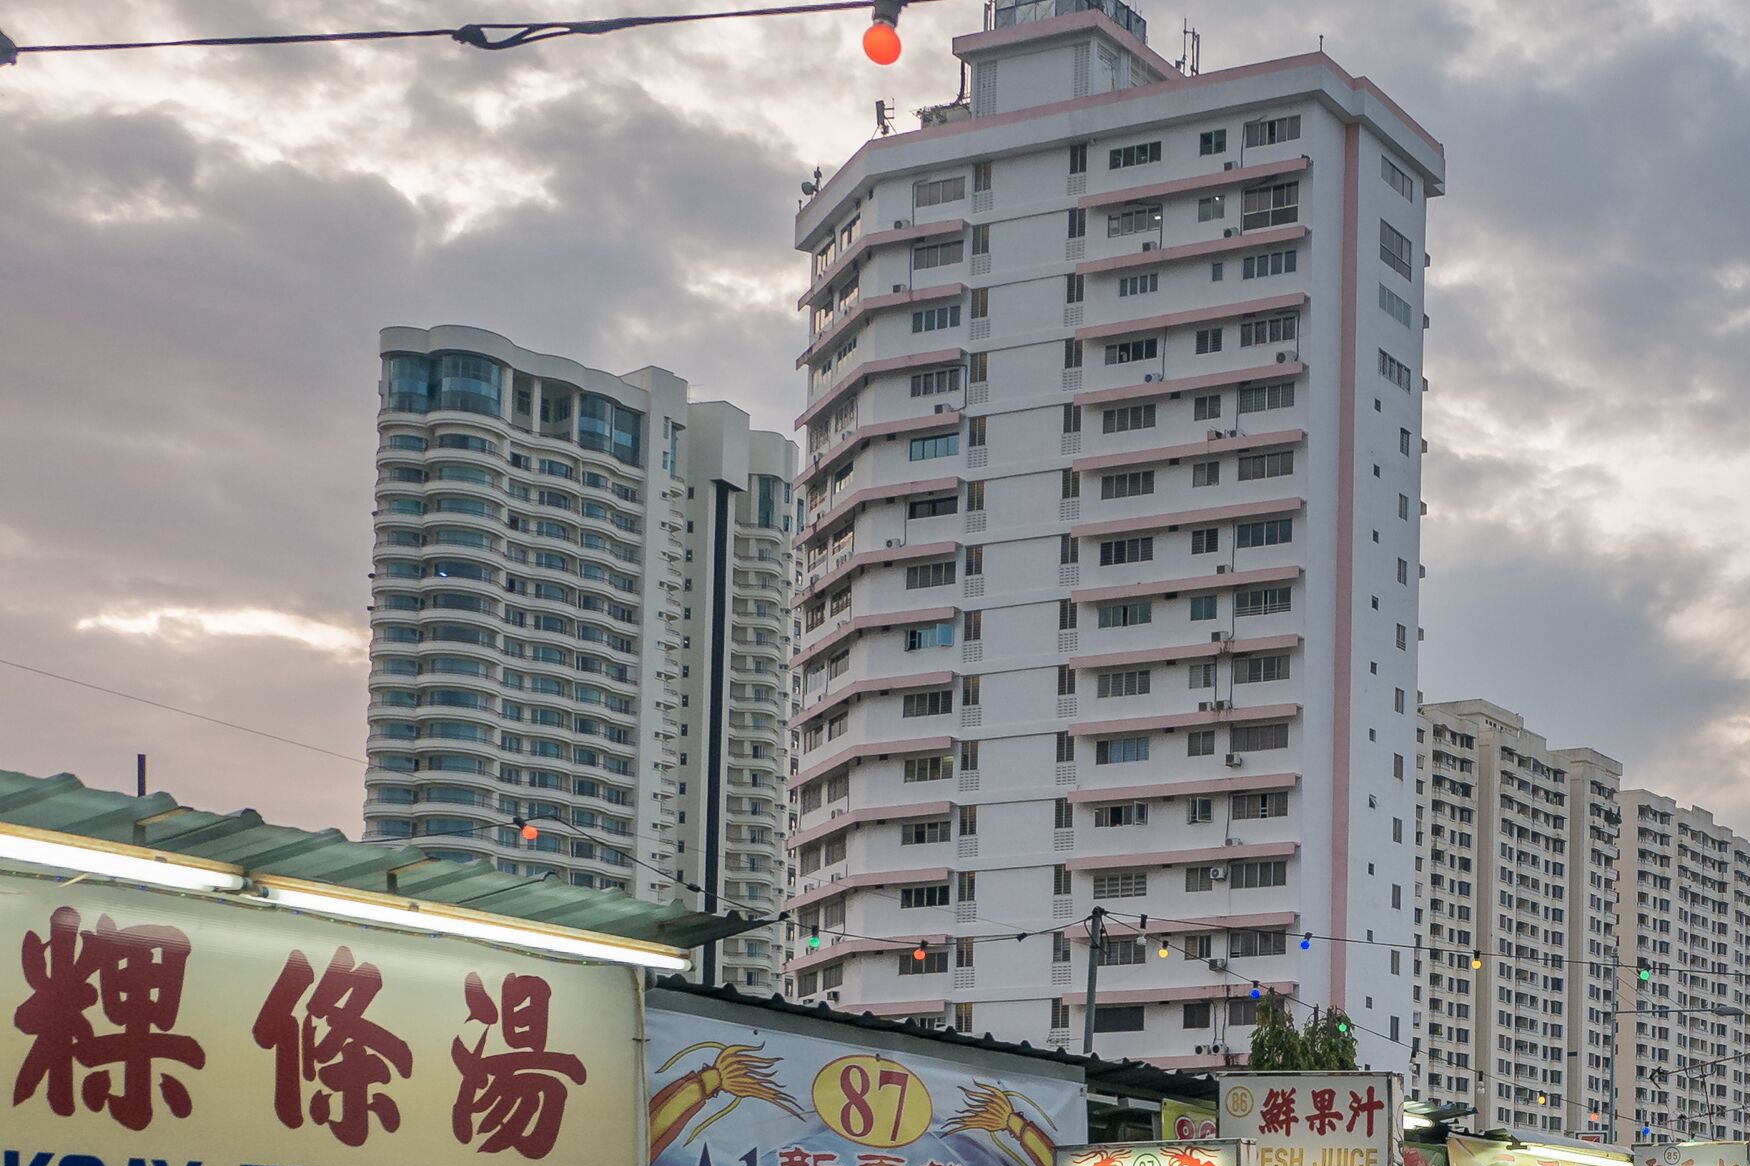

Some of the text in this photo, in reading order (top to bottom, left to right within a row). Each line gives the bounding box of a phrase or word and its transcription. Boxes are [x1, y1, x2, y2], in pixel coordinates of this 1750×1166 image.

[12, 906, 587, 1160] 粿條湯
[839, 1064, 910, 1141] 87
[1231, 1093, 1248, 1110] 86
[1258, 1086, 1385, 1138] 鮮果汁
[1667, 1152, 1678, 1160] 85
